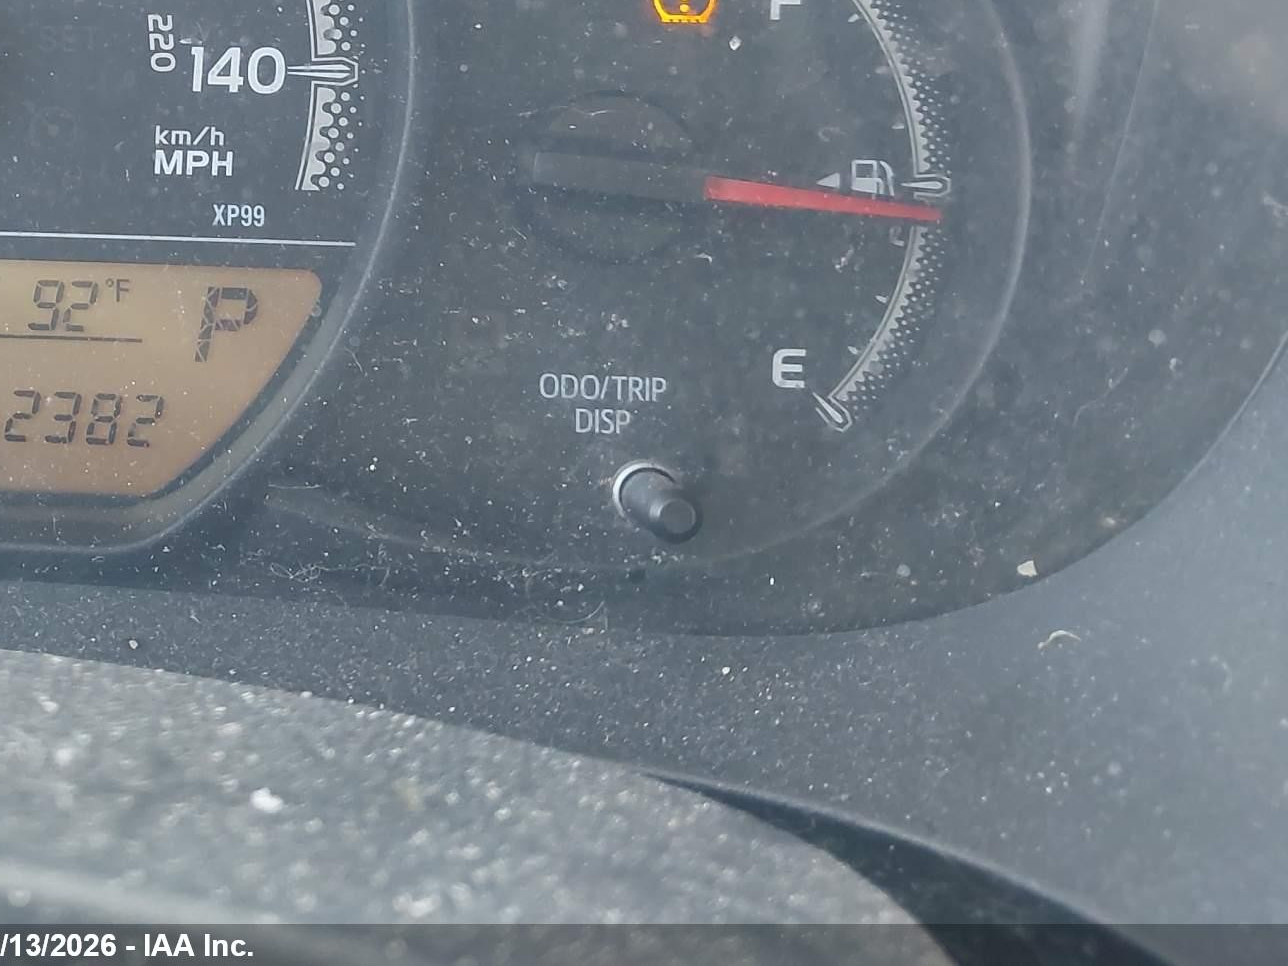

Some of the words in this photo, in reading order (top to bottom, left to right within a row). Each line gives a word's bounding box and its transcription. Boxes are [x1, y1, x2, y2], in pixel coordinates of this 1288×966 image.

[147, 14, 176, 72] 220
[191, 46, 286, 94] 140
[154, 125, 225, 146] km/h
[154, 149, 233, 176] MPH
[212, 204, 265, 226] XP99
[194, 286, 259, 362] P
[772, 348, 806, 388] E
[539, 372, 667, 402] ODO/TRIP
[575, 407, 630, 434] DISP
